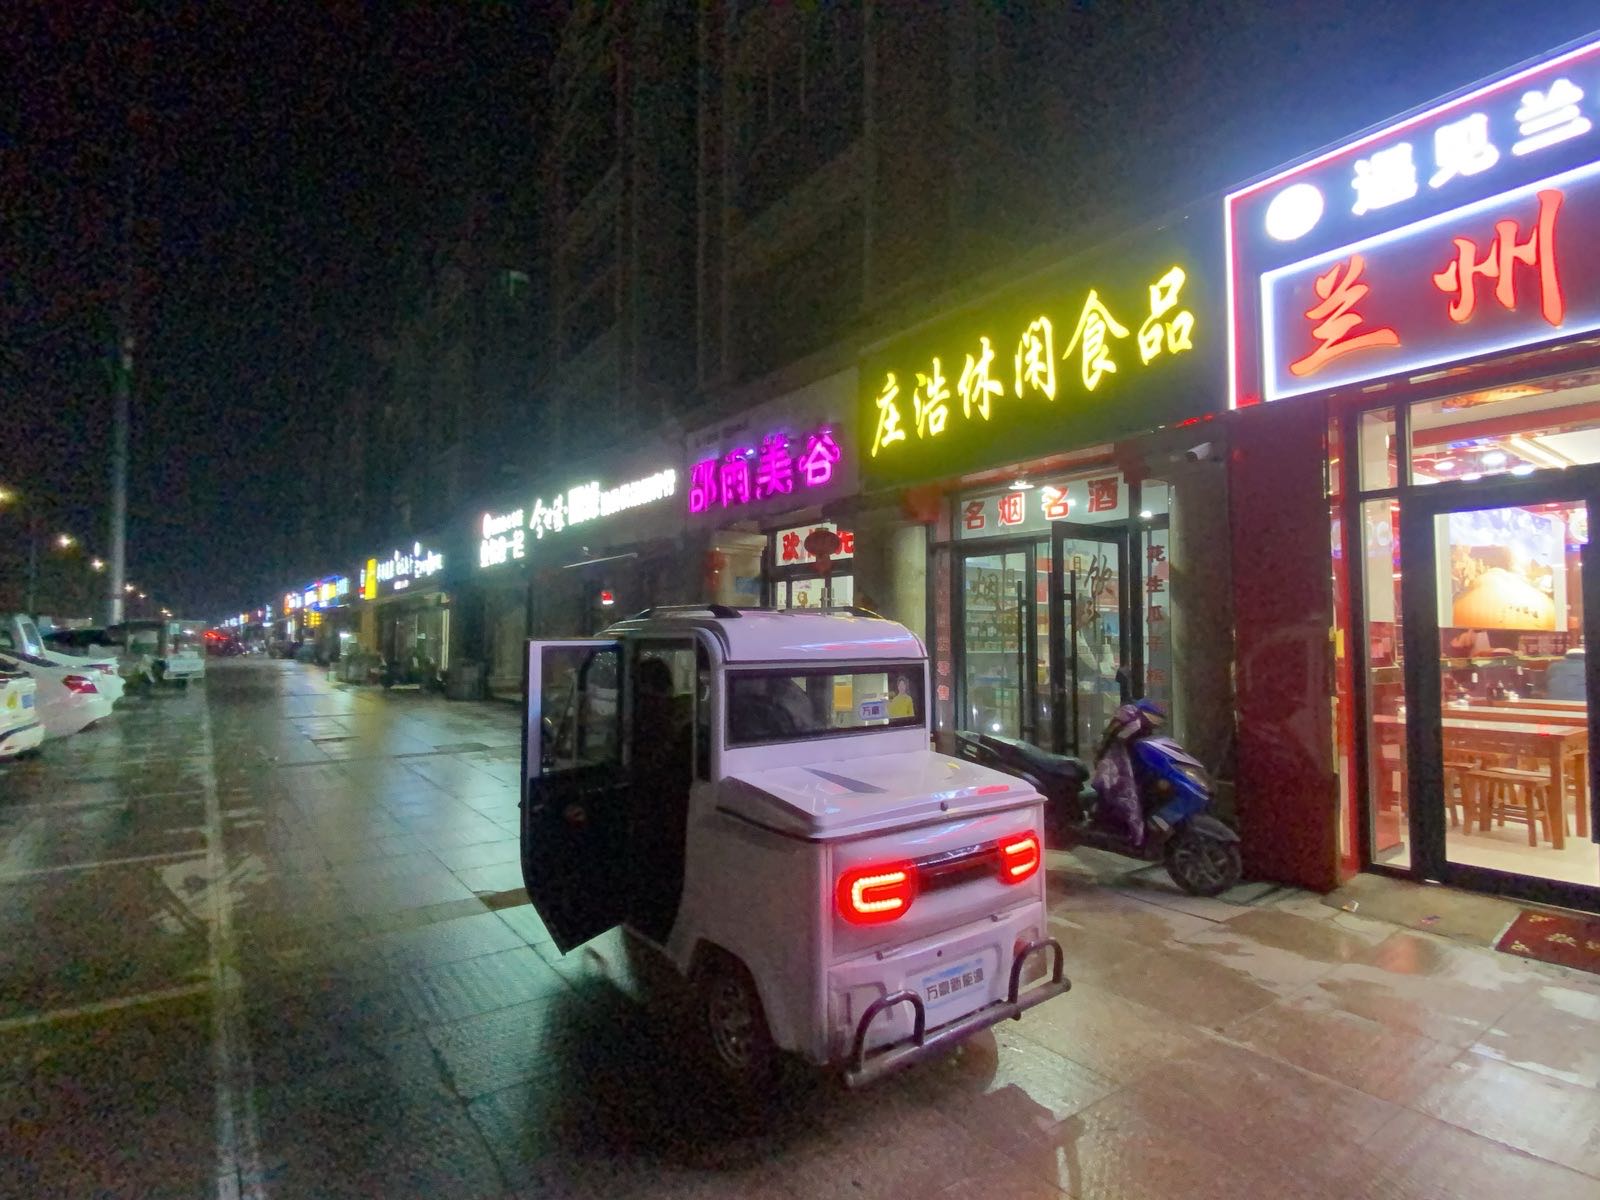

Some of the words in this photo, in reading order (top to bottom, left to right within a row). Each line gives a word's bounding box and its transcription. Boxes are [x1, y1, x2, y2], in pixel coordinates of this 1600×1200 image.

[871, 266, 1195, 458] 庄浩休闲食品
[1289, 189, 1564, 377] 兰州
[964, 476, 1119, 530] 名烟名酒
